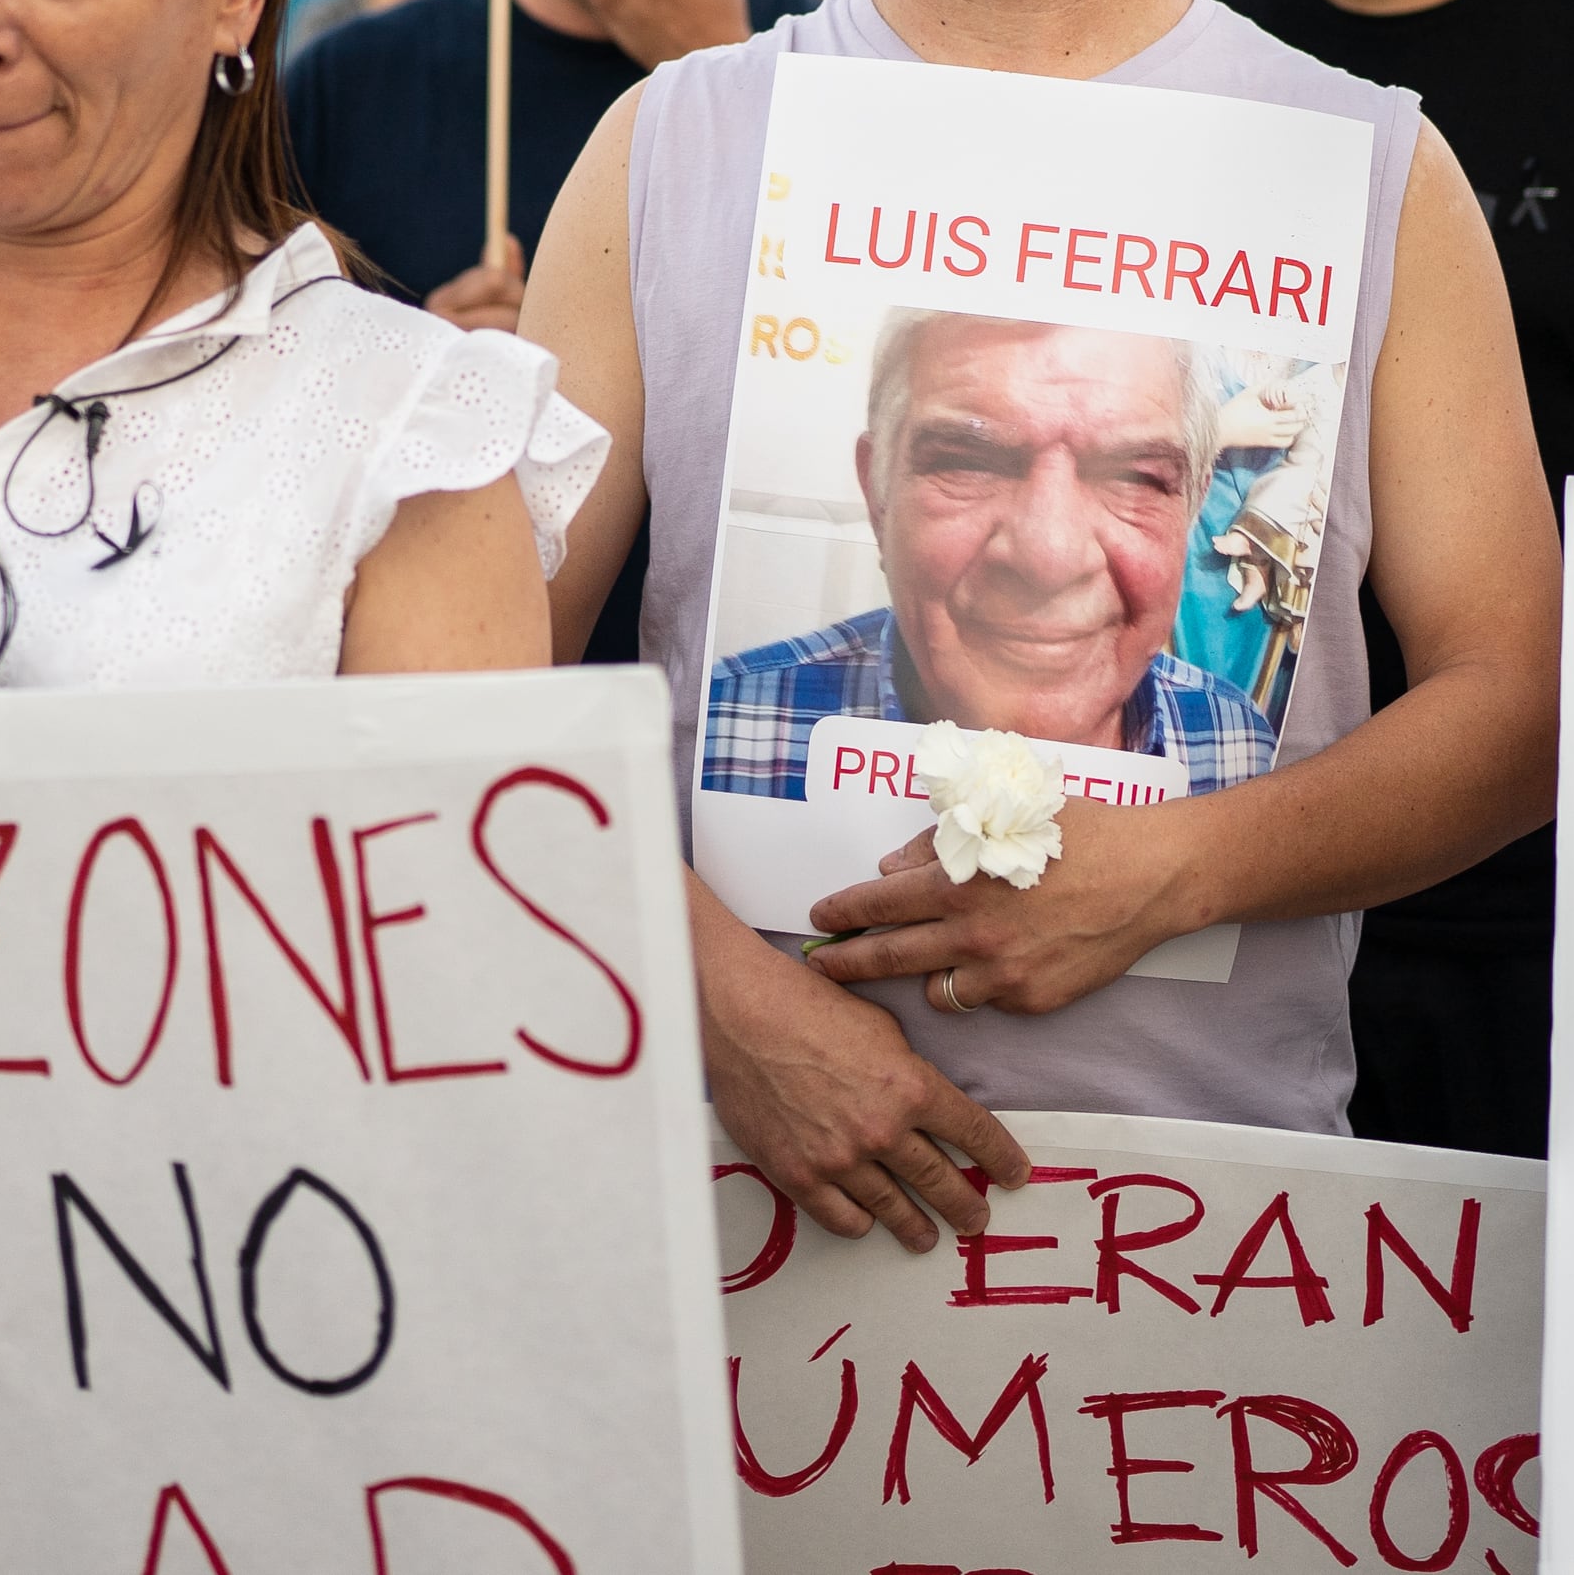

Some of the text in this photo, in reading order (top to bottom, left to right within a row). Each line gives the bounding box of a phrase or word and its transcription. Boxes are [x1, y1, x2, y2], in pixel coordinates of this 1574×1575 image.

[824, 202, 991, 279] LUIS
[1016, 223, 1334, 328] FERRARI
[51, 1161, 396, 1397] NO
[946, 1166, 1481, 1333] ERAN
